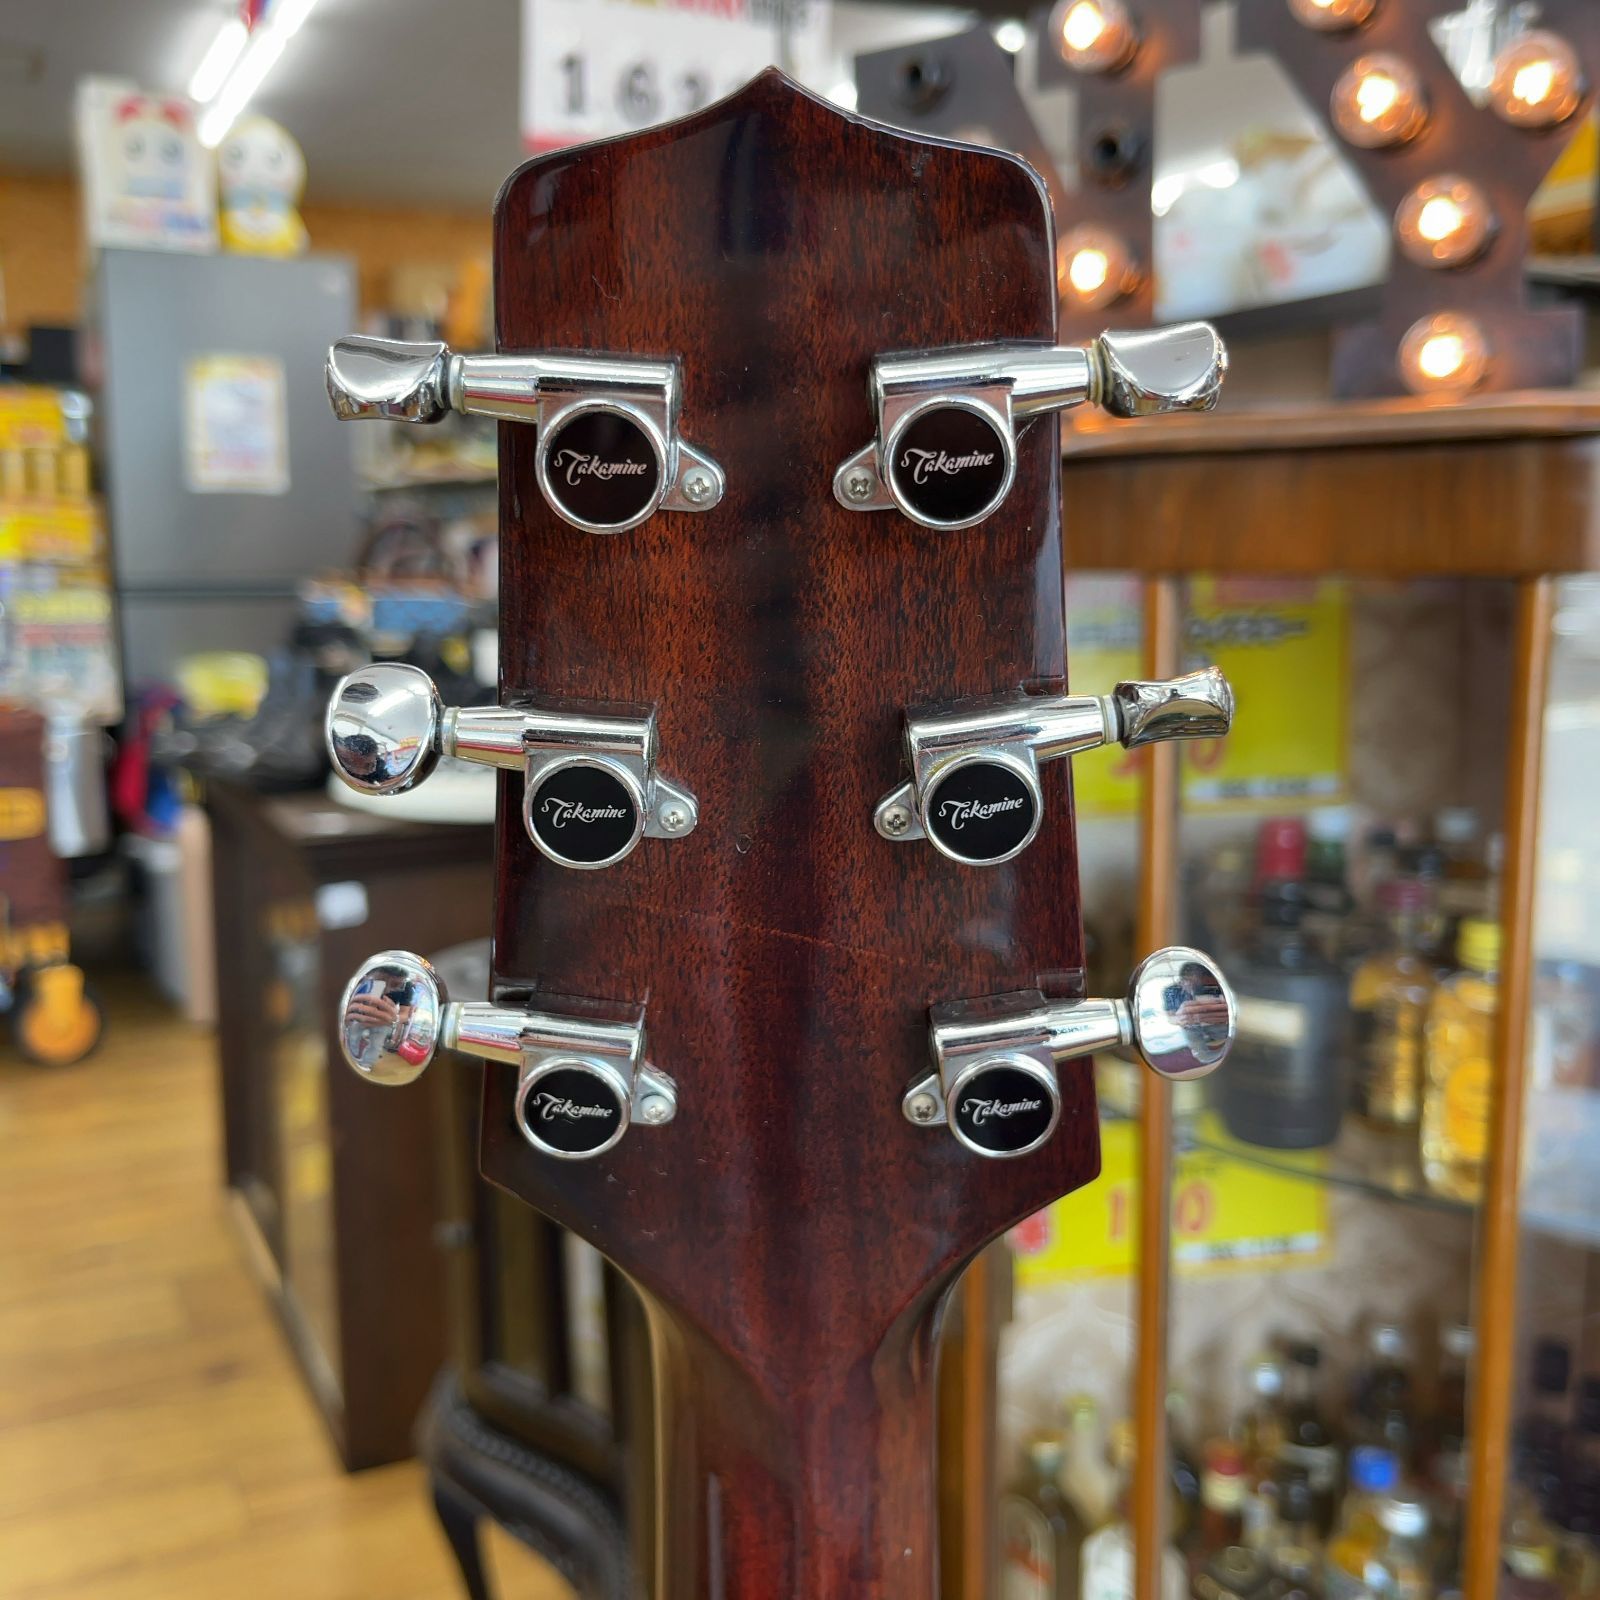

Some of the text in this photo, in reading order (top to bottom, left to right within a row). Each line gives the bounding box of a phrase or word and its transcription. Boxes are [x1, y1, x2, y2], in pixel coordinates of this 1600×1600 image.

[553, 448, 648, 487] Takamine
[900, 447, 995, 486] Takamine
[541, 796, 628, 829] Takamine
[938, 795, 1024, 829] Takamine
[532, 1091, 614, 1120] Takamine
[961, 1097, 1041, 1125] Takamine
